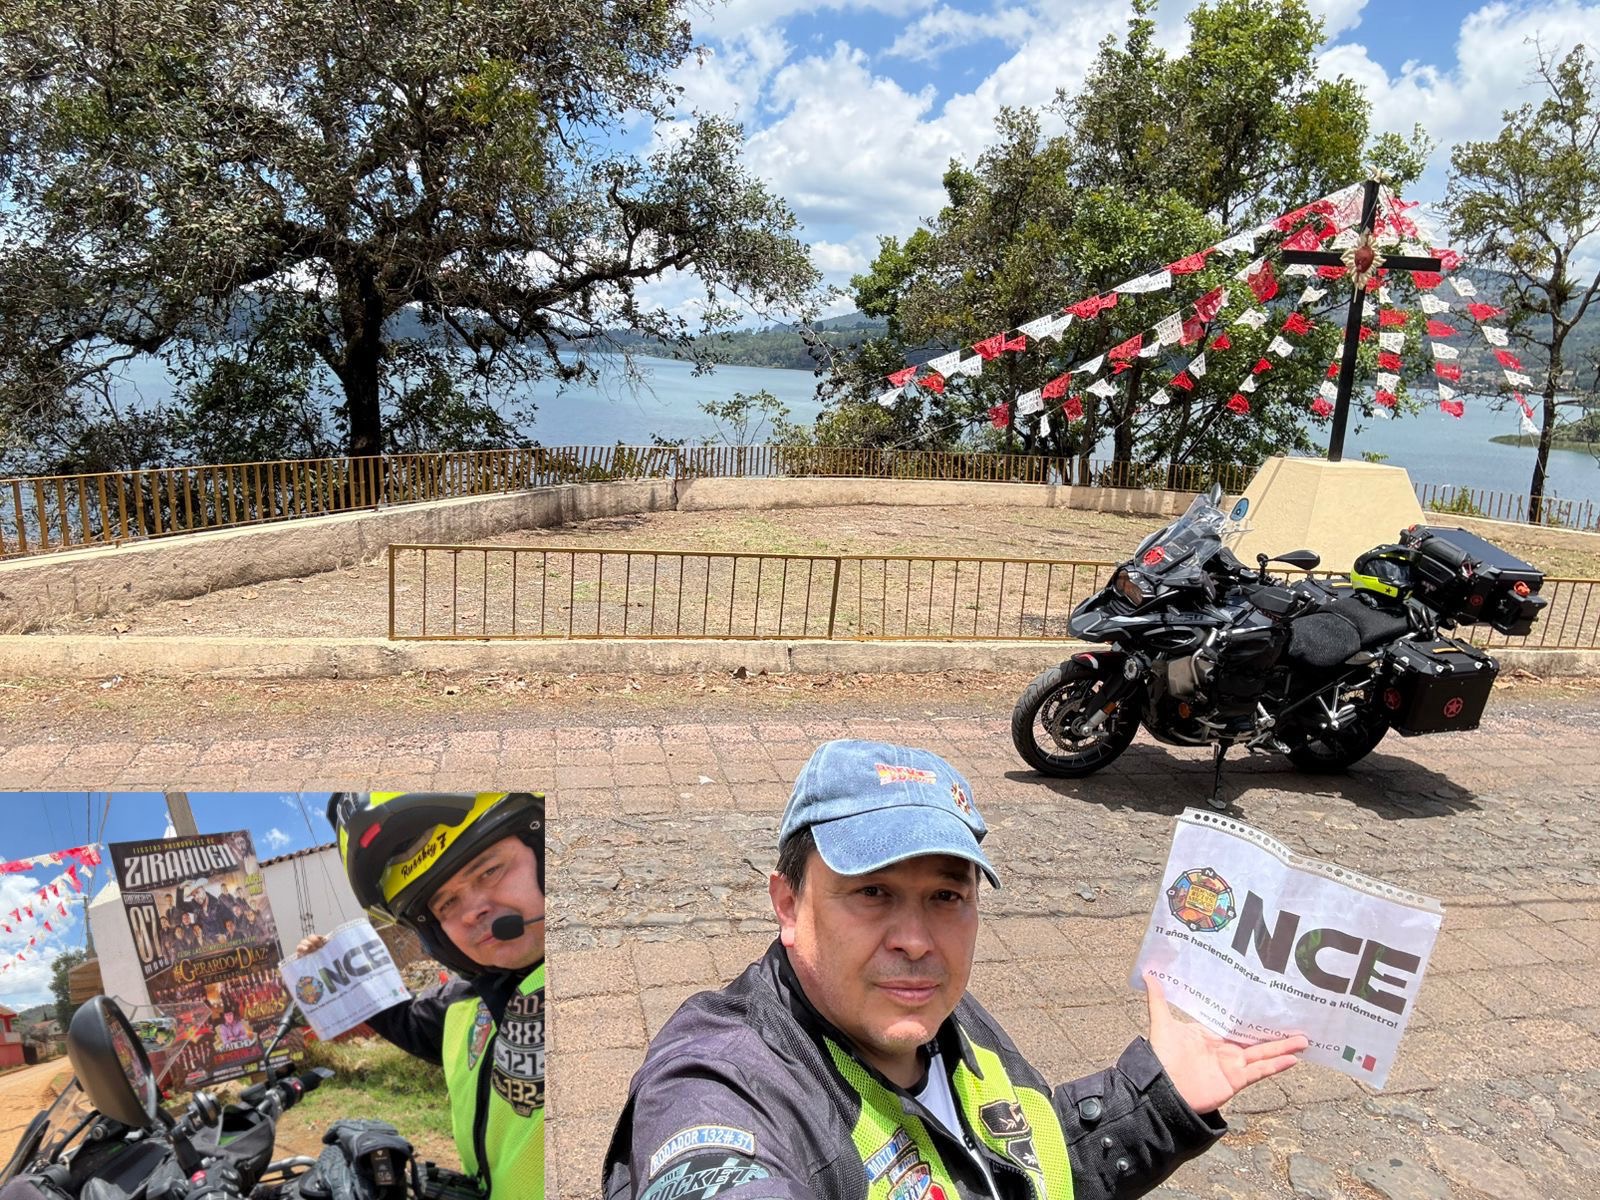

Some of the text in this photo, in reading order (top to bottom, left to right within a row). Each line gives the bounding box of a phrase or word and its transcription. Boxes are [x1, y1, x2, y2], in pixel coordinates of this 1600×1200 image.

[436, 831, 448, 851] 7
[129, 905, 162, 963] 07
[179, 955, 235, 982] GERARDO
[318, 938, 391, 994] NCE
[1231, 889, 1421, 1016] NCE
[1155, 926, 1164, 934] 11
[1165, 929, 1189, 941] años
[1190, 936, 1233, 965] haciendo
[1269, 979, 1327, 1005] ¡kilómetro
[1339, 1000, 1398, 1029] kilómetro!
[1148, 969, 1179, 985] MOTO
[1184, 983, 1227, 1015] TURISMO
[1229, 1014, 1243, 1026] EN
[1308, 1039, 1341, 1052] EXICO
[507, 1020, 542, 1045] 88
[505, 1049, 537, 1075] 121
[504, 1078, 537, 1106] 132
[652, 1130, 699, 1169] RODADOR
[867, 1146, 893, 1175] MOTO
